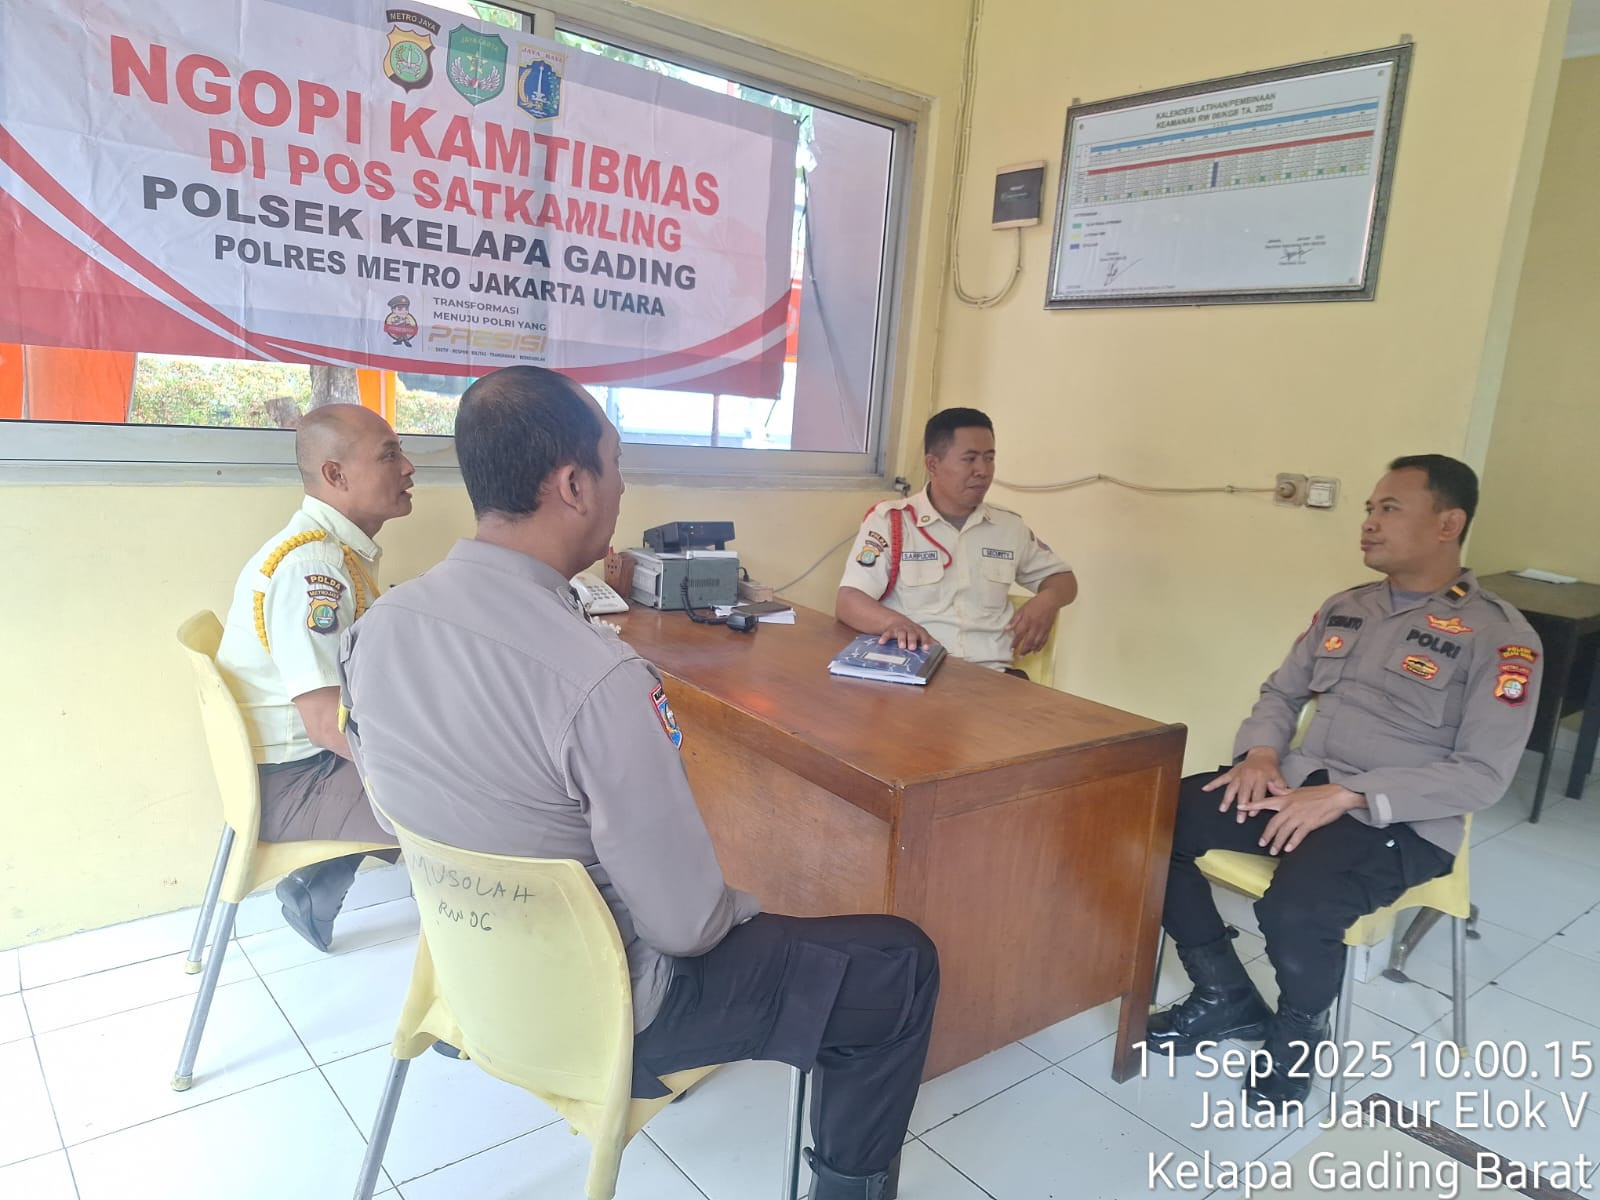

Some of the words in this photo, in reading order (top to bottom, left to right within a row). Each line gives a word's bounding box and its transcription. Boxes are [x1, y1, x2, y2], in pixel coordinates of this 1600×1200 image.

[389, 12, 417, 23] METRO
[418, 15, 437, 32] JAYA
[110, 35, 362, 145] NGOPI
[389, 101, 720, 216] KAMTIBMAS
[208, 127, 266, 180] DI
[288, 143, 395, 195] POS
[413, 170, 681, 252] SATKAMLING
[142, 175, 362, 241] POLSEK
[380, 212, 550, 268] KELAPA
[563, 244, 696, 291] GADING
[214, 234, 346, 275] POLRES
[357, 256, 459, 290] METRO
[469, 269, 585, 303] JAKARTA
[592, 289, 665, 318] UTARA
[433, 297, 520, 316] TRANSFORMASI
[433, 311, 480, 325] MENUJU
[482, 317, 515, 328] POLRI
[518, 321, 547, 332] YANG
[428, 324, 548, 353] PRESISI
[310, 576, 341, 590] POLDA
[1406, 629, 1461, 659] POLRI
[412, 852, 536, 903] MUSOLAH
